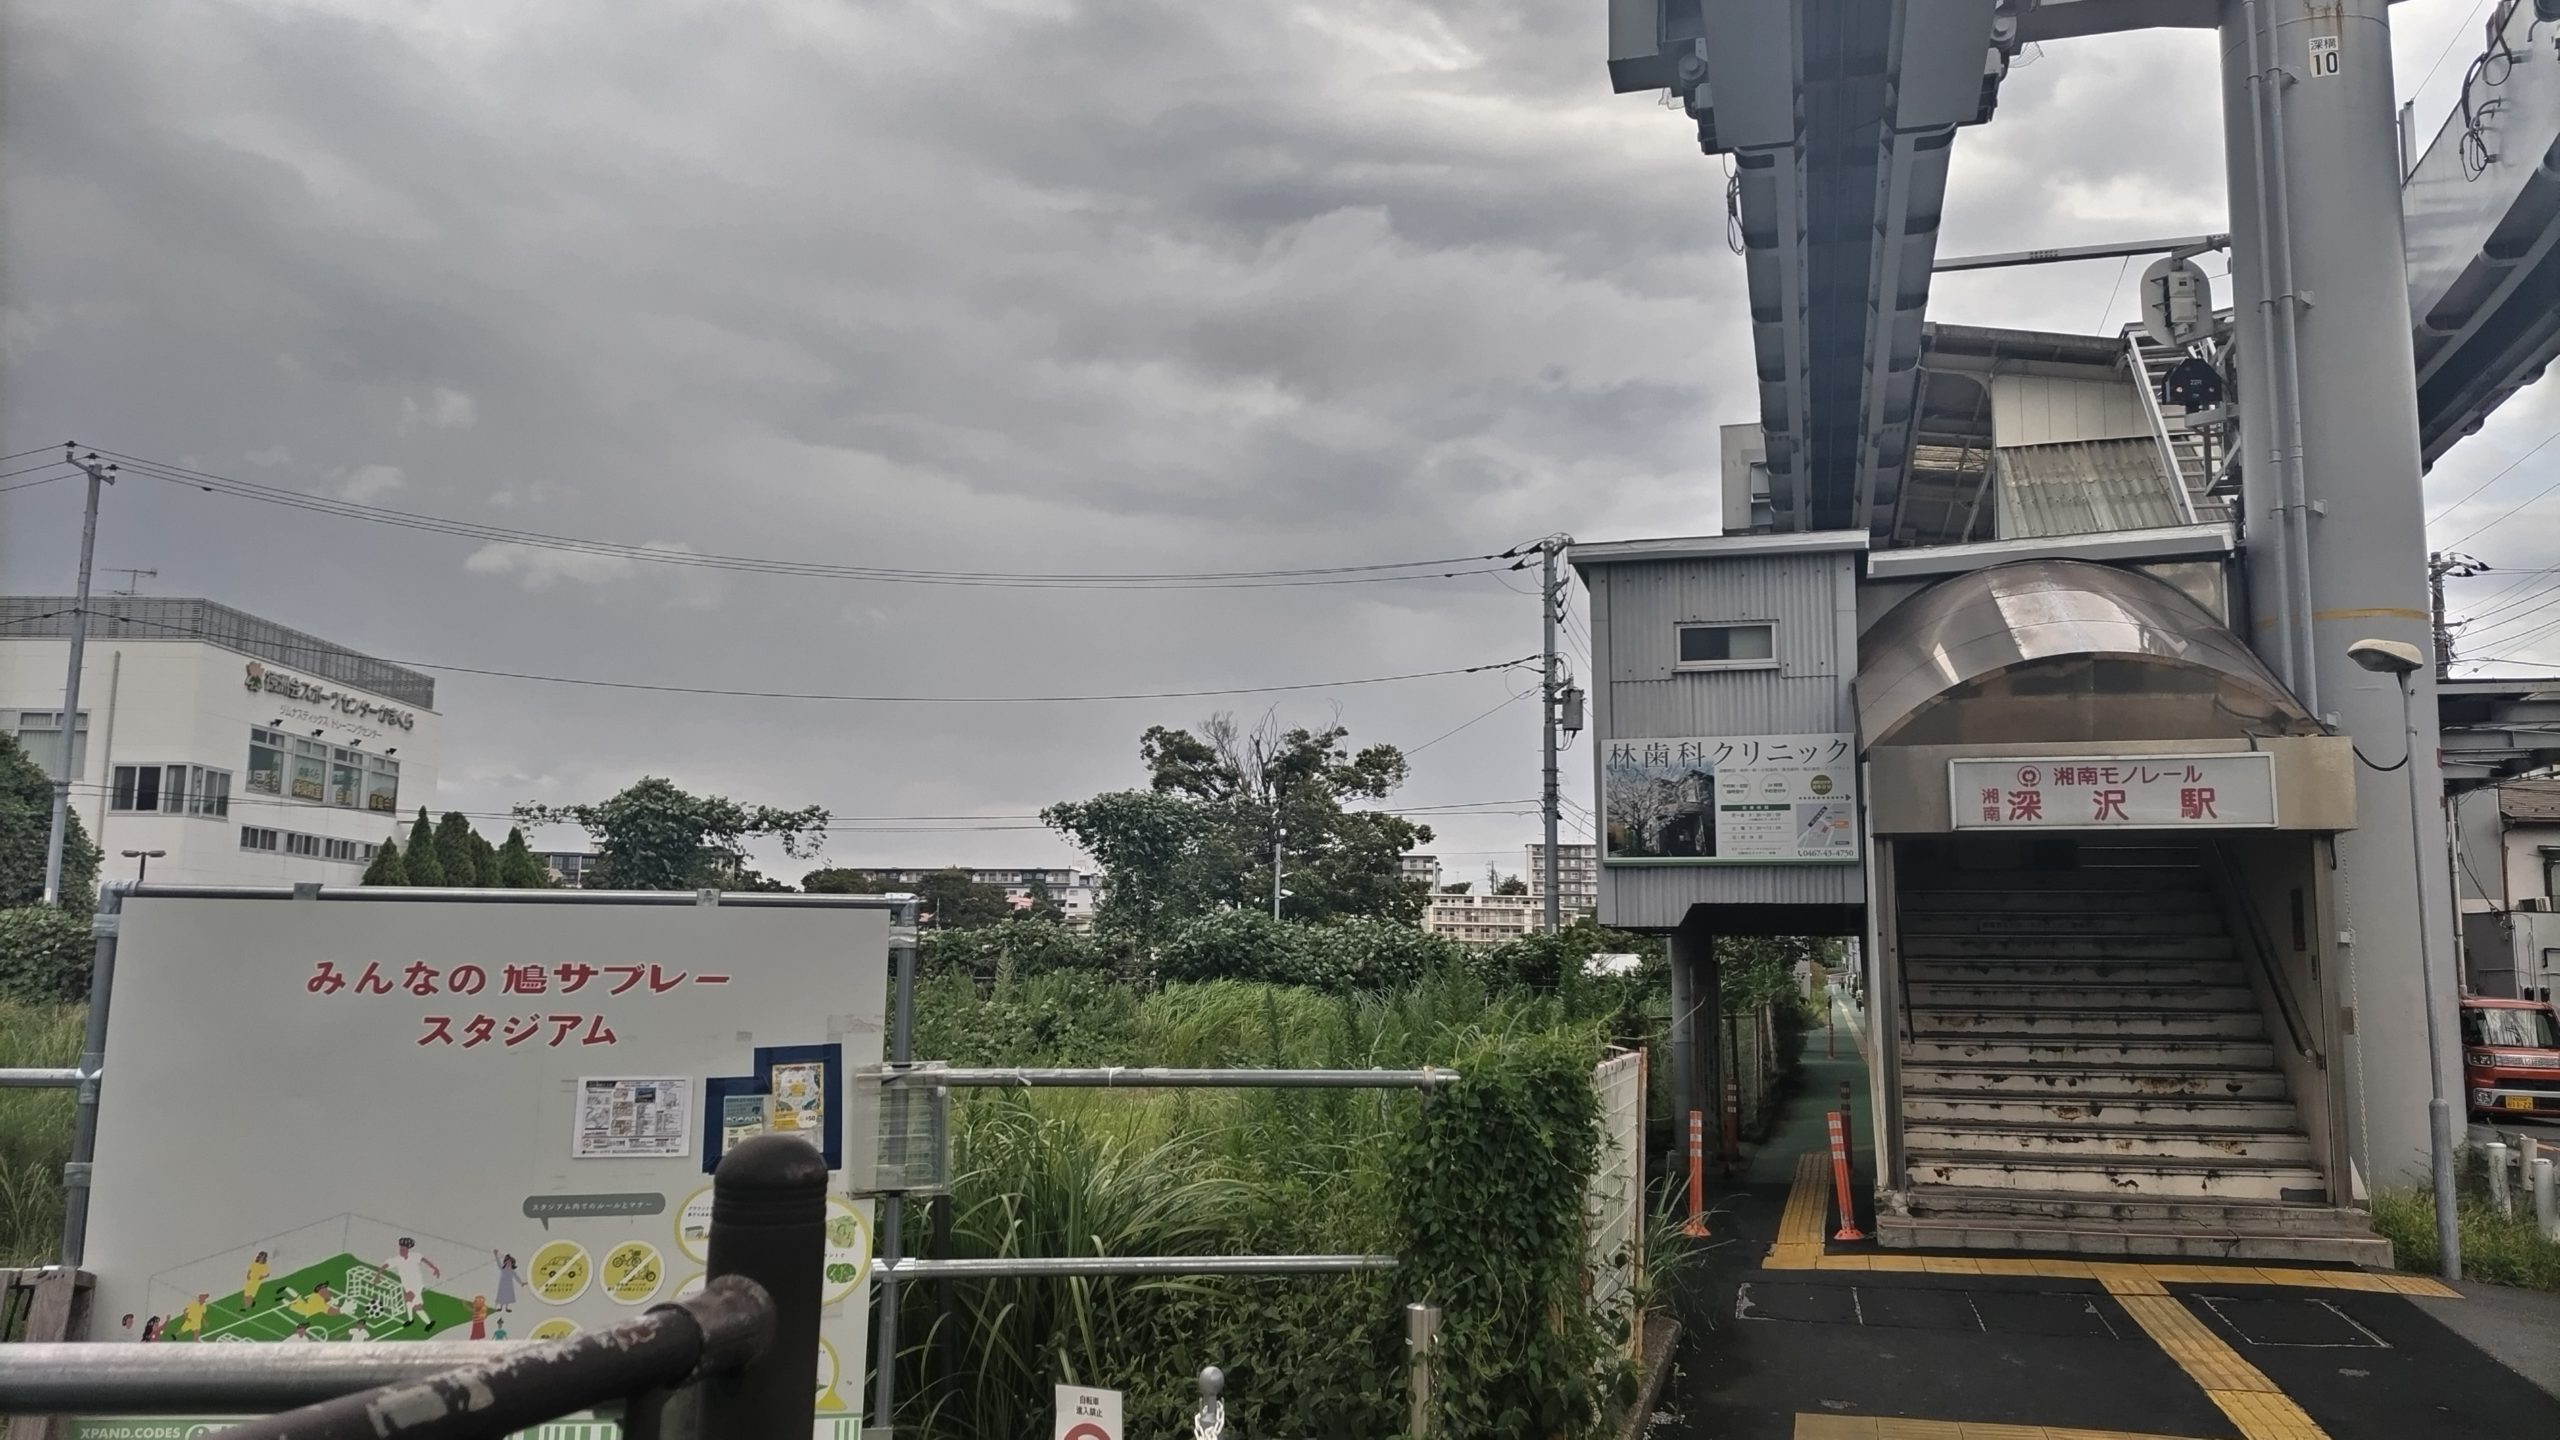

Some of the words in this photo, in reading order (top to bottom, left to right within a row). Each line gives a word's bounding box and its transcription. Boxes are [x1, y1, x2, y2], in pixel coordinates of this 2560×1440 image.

[2313, 52, 2338, 75] 10
[1607, 738, 1849, 771] 林歯科クリニック
[2053, 765, 2204, 786] 湘南モノレール
[1982, 788, 2000, 822] 湘南
[2007, 787, 2218, 822] 深沢駅
[1802, 849, 1854, 857] 0467-43-4750
[416, 1013, 618, 1047] スタジアム
[531, 1201, 653, 1211] スタジアム内でのルールとマナー
[1079, 1395, 1099, 1405] 自転車
[1076, 1406, 1103, 1418] 進入禁止
[80, 1427, 181, 1439] XPAND.CODES
